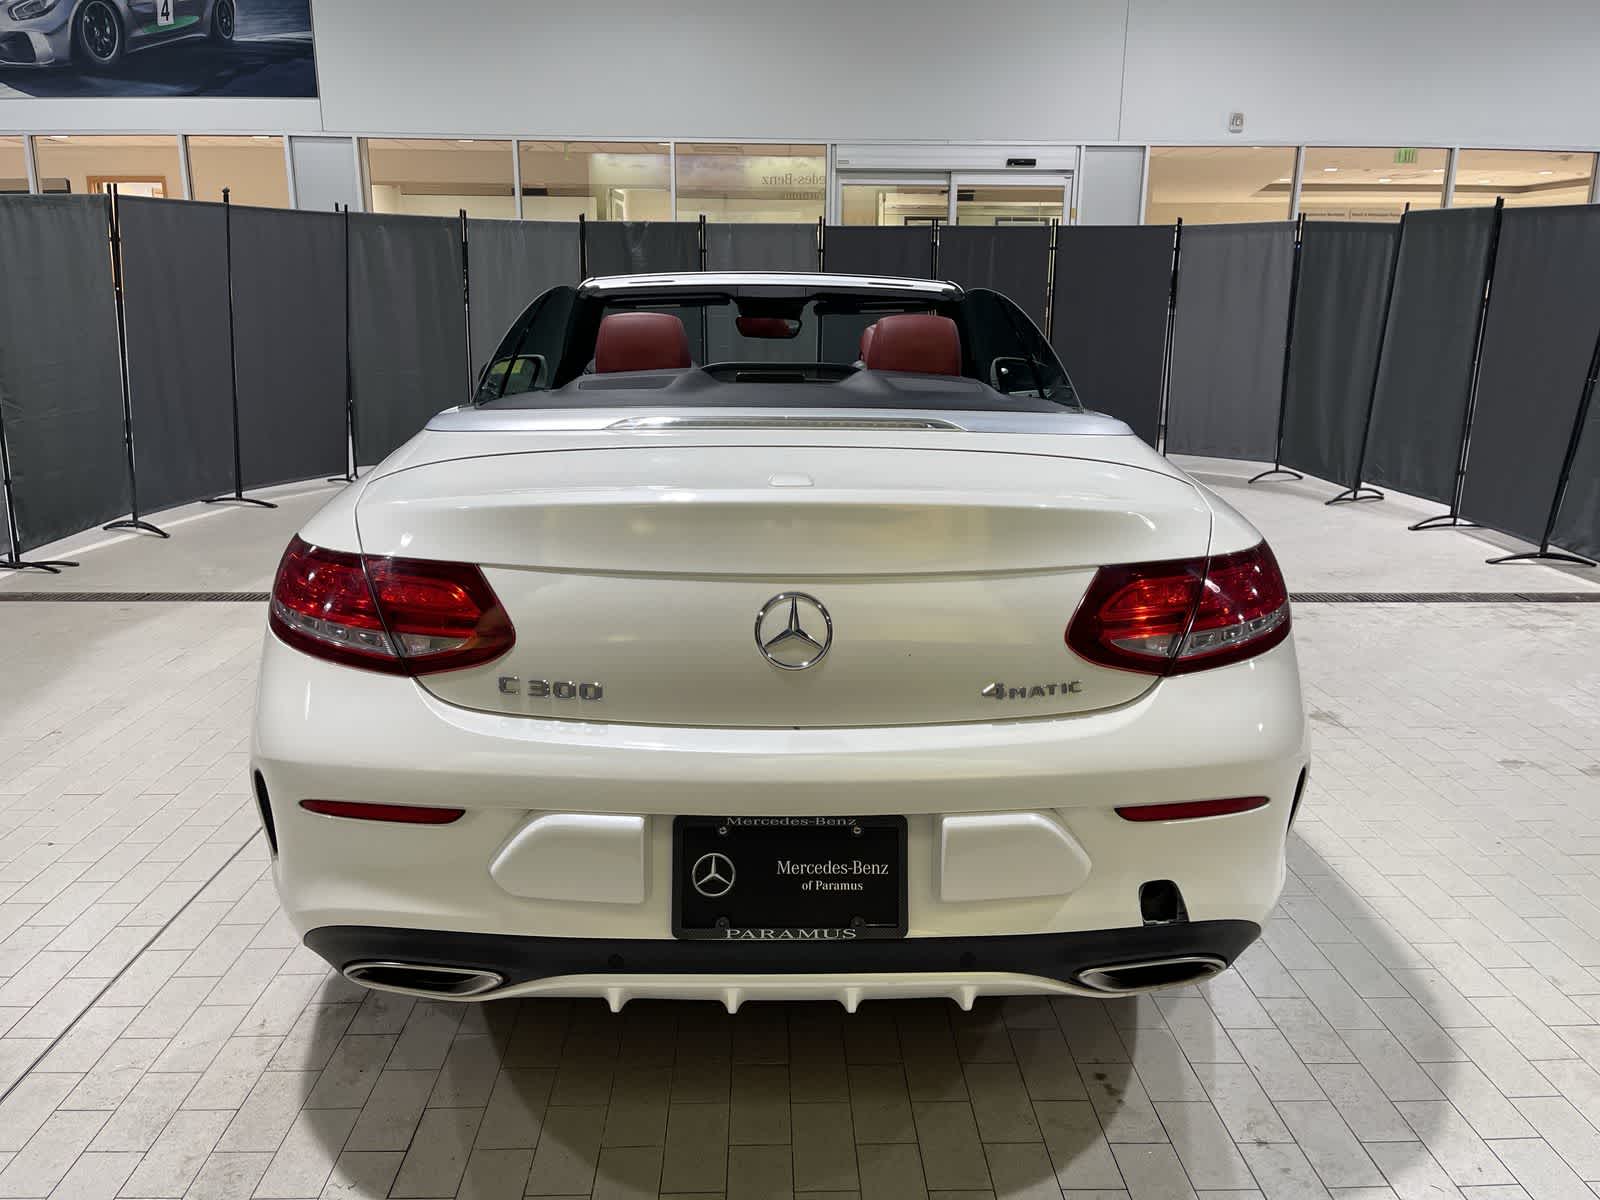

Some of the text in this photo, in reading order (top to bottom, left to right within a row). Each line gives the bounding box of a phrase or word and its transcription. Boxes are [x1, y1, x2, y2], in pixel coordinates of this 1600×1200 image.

[161, 0, 169, 21] 4
[498, 675, 604, 701] C 300
[981, 680, 1083, 700] 4MATIC
[726, 816, 857, 826] Mercedes-Benz
[776, 860, 889, 875] Mercedes-Benz
[801, 880, 864, 891] of Paramus
[726, 928, 857, 939] PARAMUS
